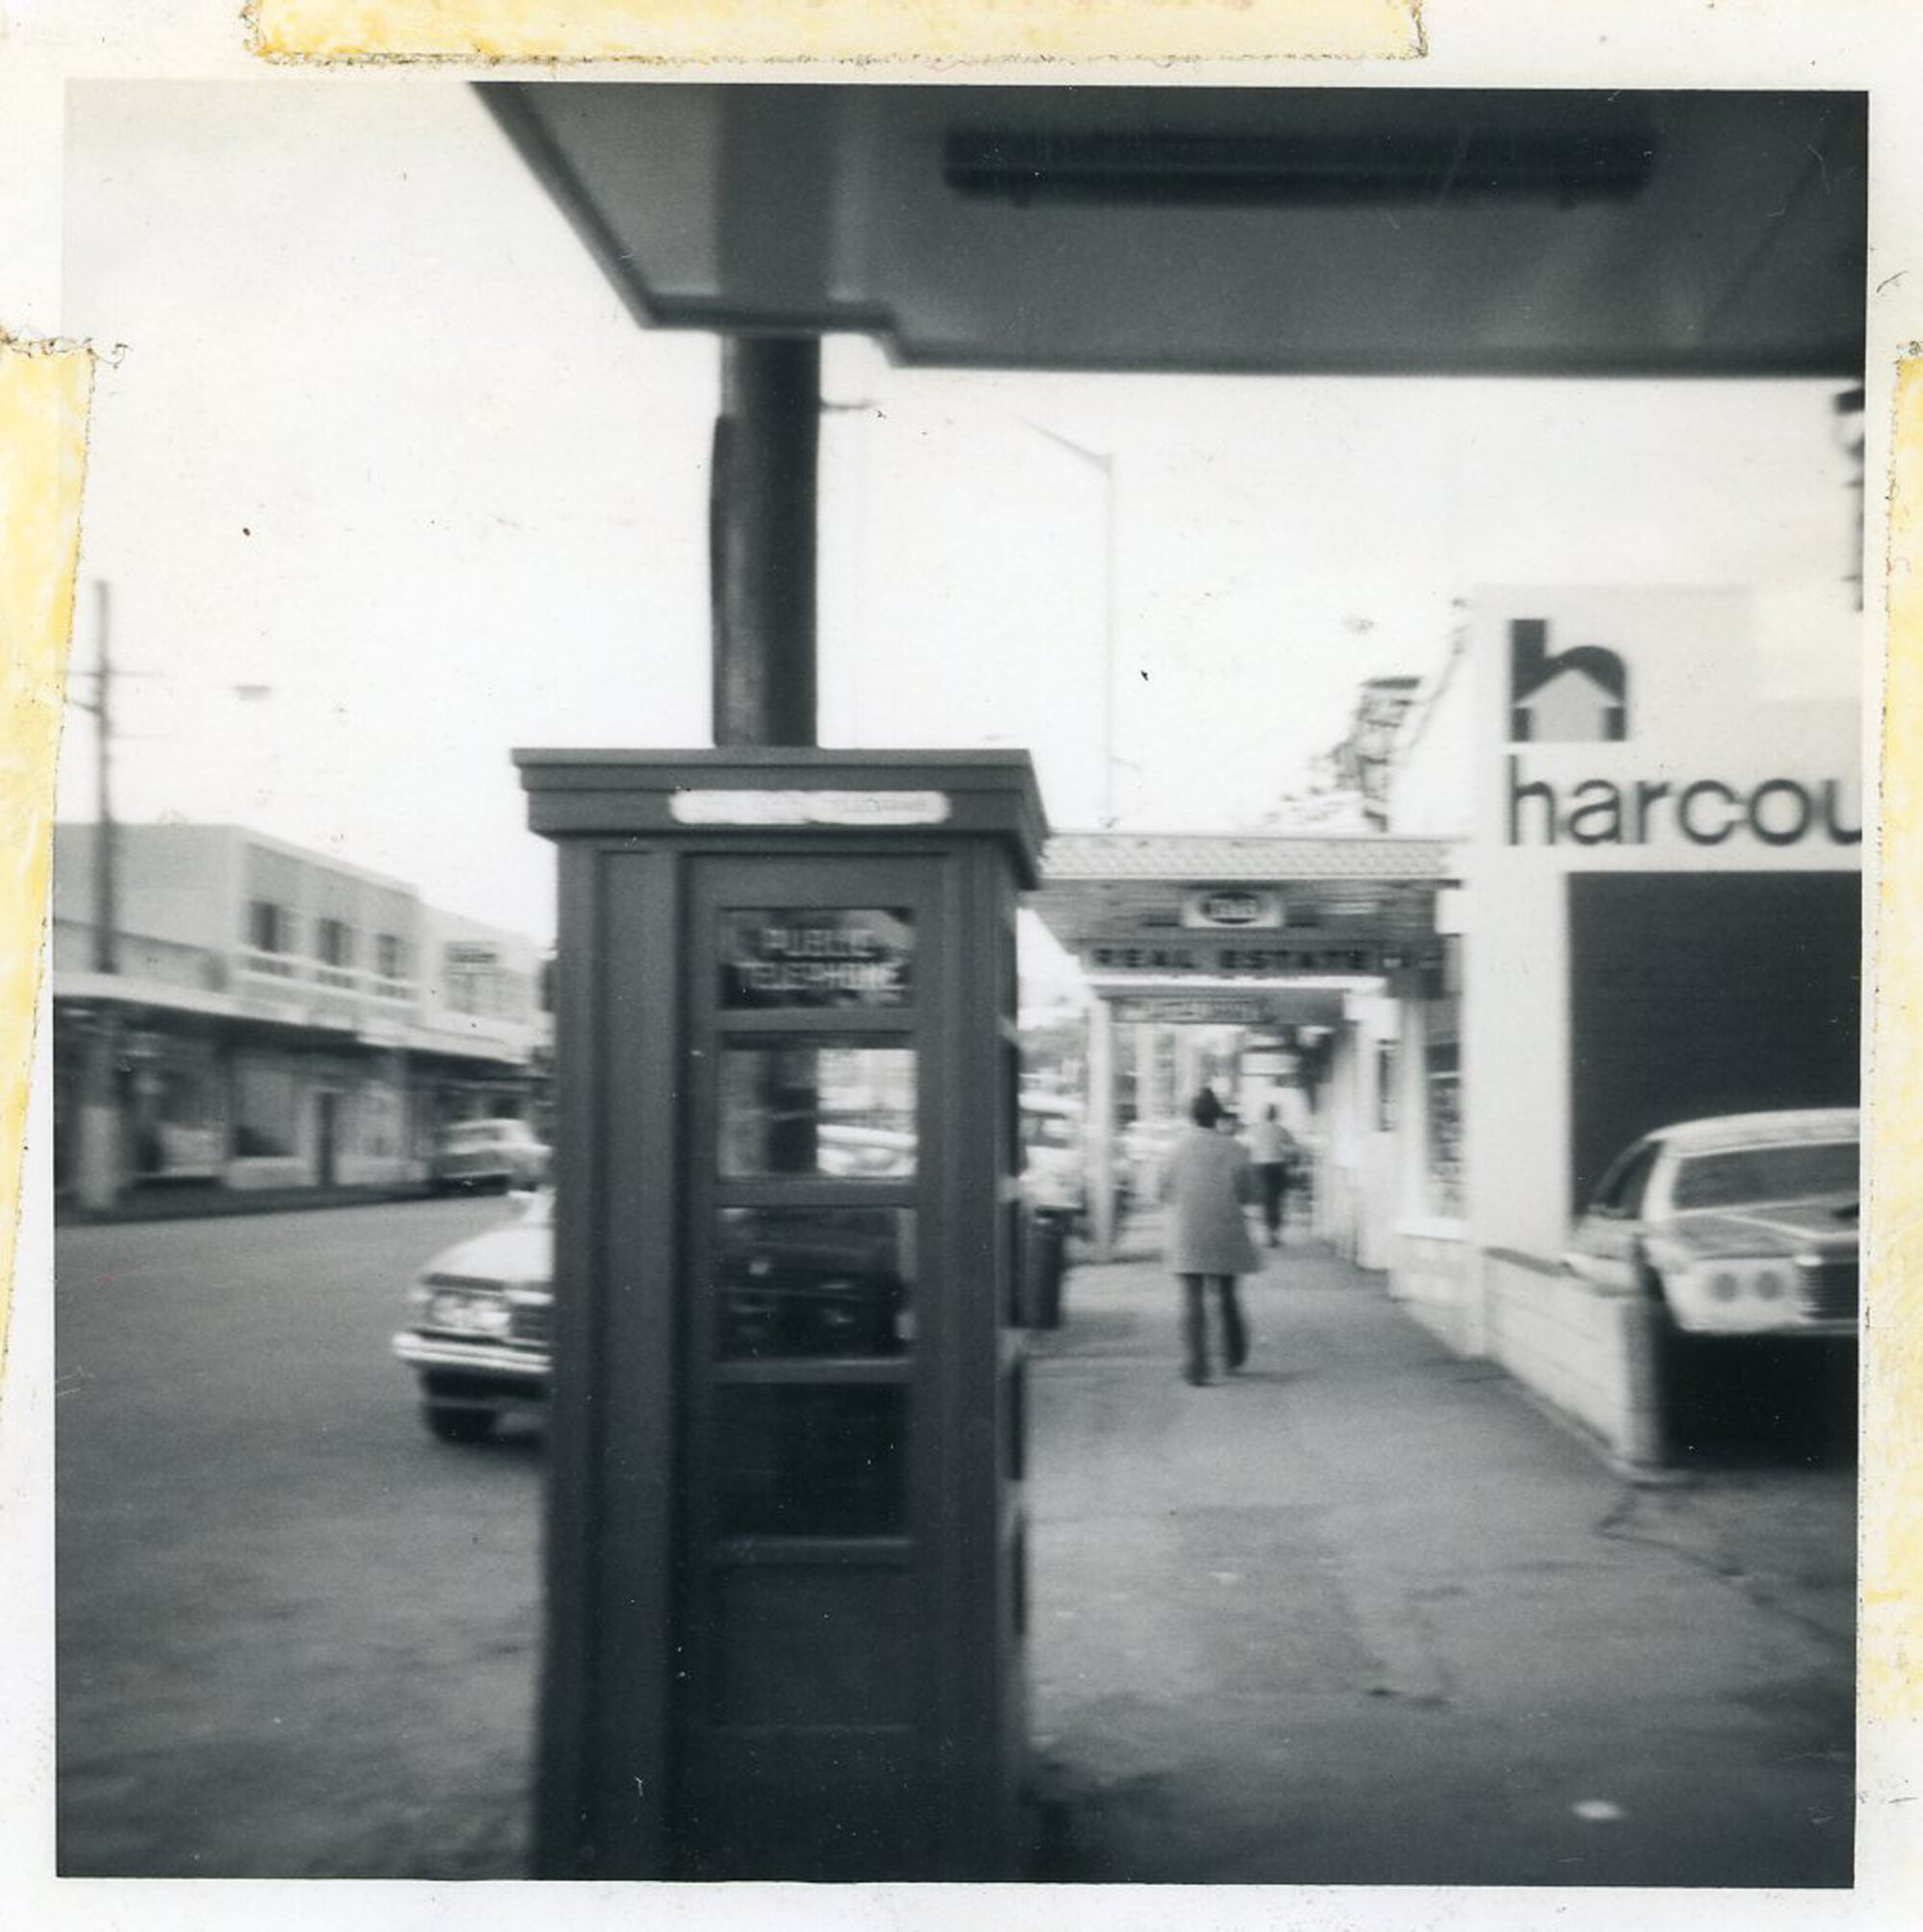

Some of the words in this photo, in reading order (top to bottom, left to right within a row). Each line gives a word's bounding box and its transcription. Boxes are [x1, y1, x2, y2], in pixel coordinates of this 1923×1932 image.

[1509, 753, 1862, 846] harcou
[763, 928, 876, 957] PUBLIC
[1094, 948, 1194, 969] REAL
[1218, 947, 1373, 969] ESTATE
[733, 962, 907, 991] TELEPHONE
